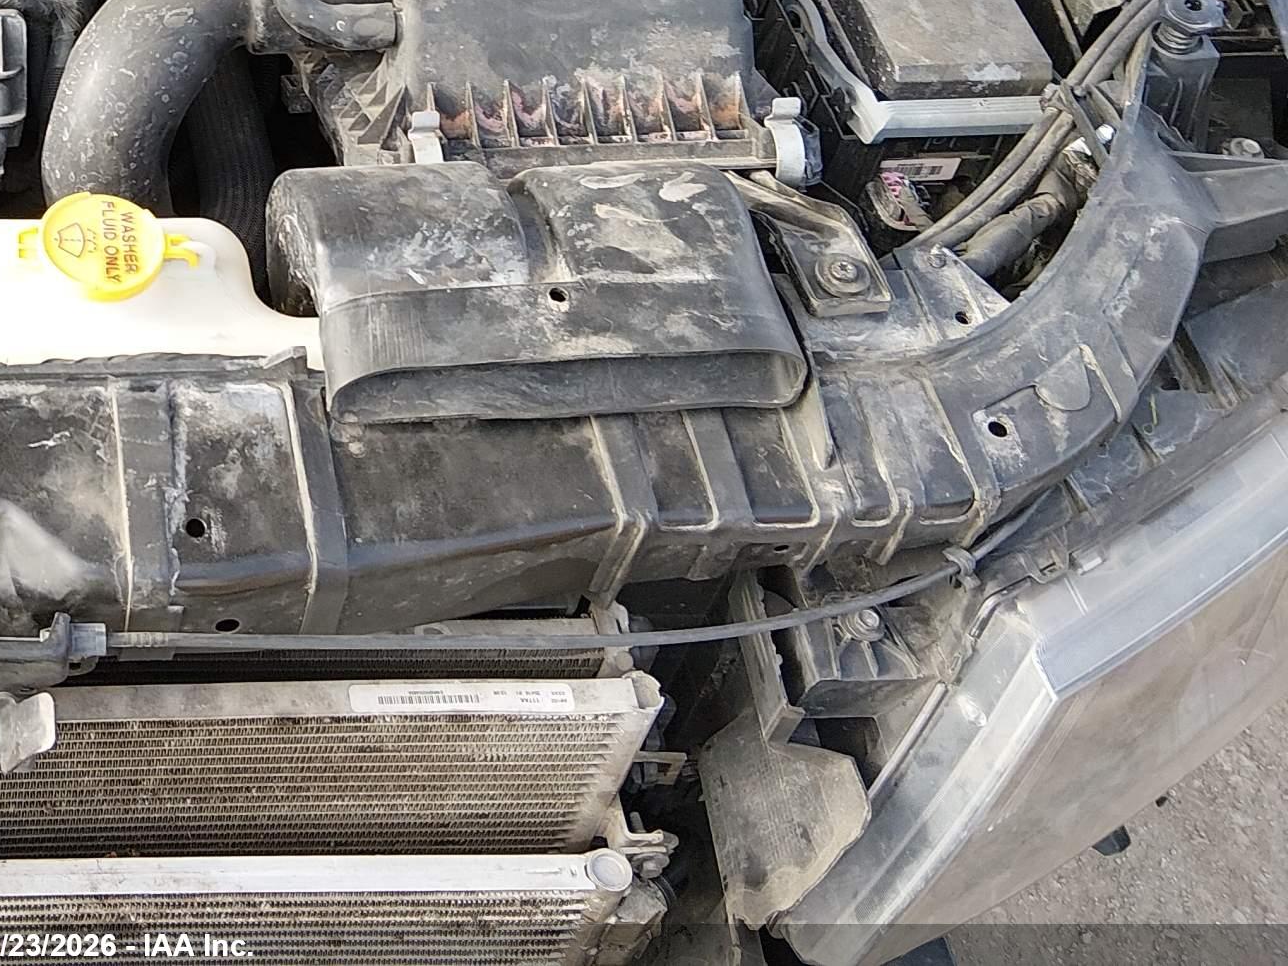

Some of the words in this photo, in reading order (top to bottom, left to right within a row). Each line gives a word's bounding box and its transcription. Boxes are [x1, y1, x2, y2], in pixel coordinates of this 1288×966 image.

[100, 200, 117, 241] FLUID
[119, 211, 140, 274] WASHER
[103, 245, 122, 283] ONLY
